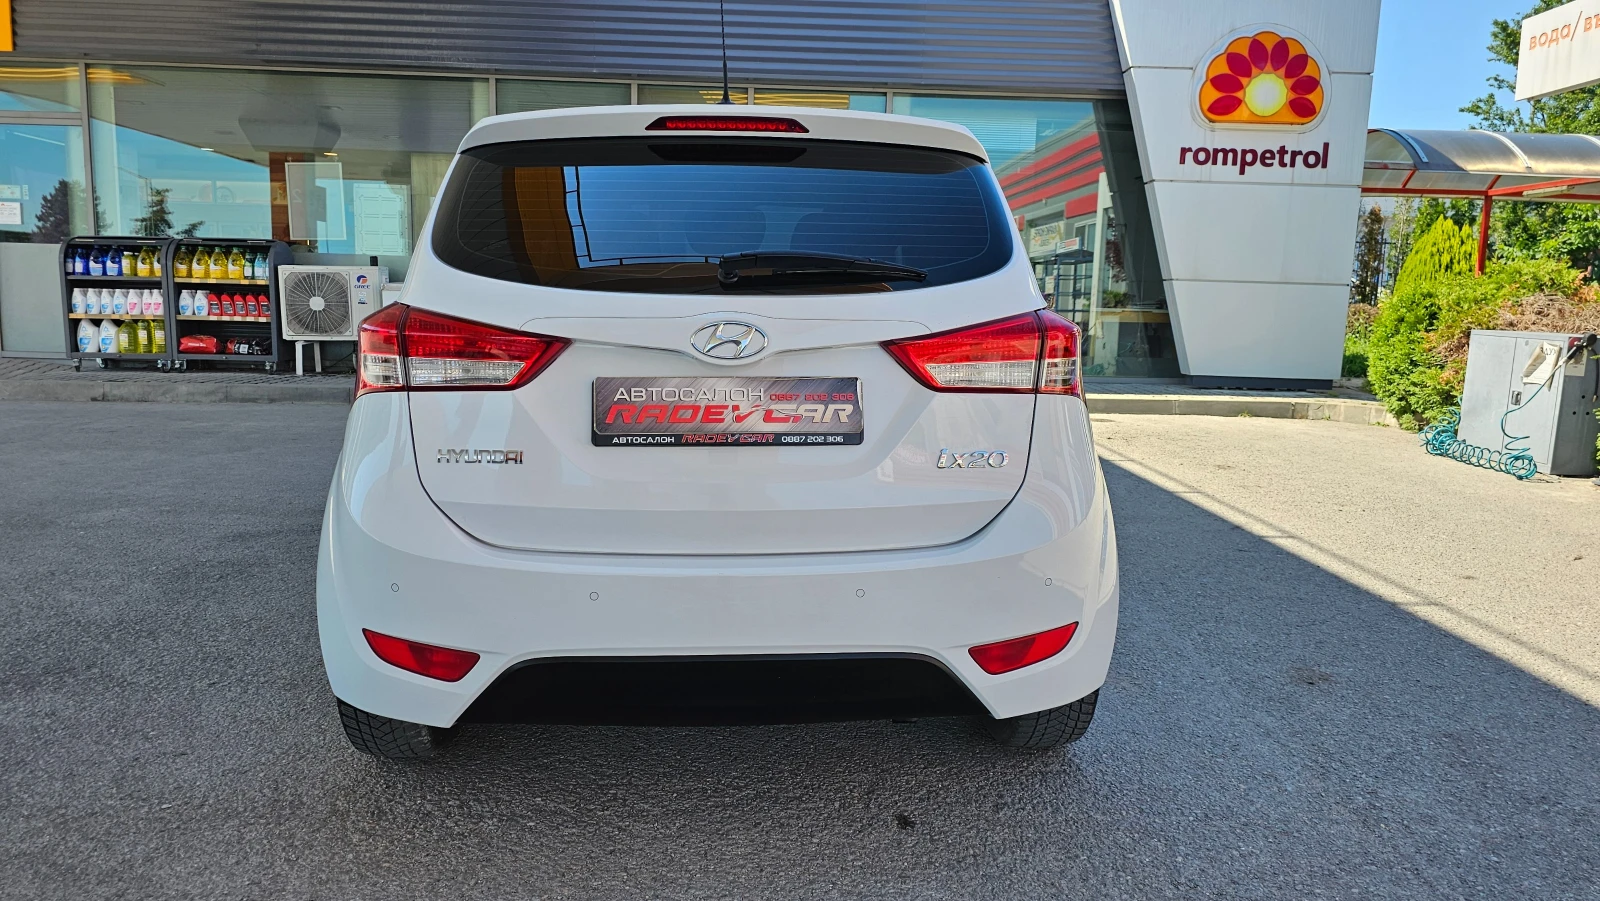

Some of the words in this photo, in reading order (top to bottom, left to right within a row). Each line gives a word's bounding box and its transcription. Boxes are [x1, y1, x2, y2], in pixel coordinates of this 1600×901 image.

[1179, 142, 1330, 175] rompetrol
[613, 387, 764, 401] АВТОСАЛОН
[781, 435, 805, 443] 0887
[807, 435, 824, 443] 202
[826, 435, 844, 443] 306
[437, 448, 524, 464] HYUNDAI
[937, 448, 1009, 469] ix20
